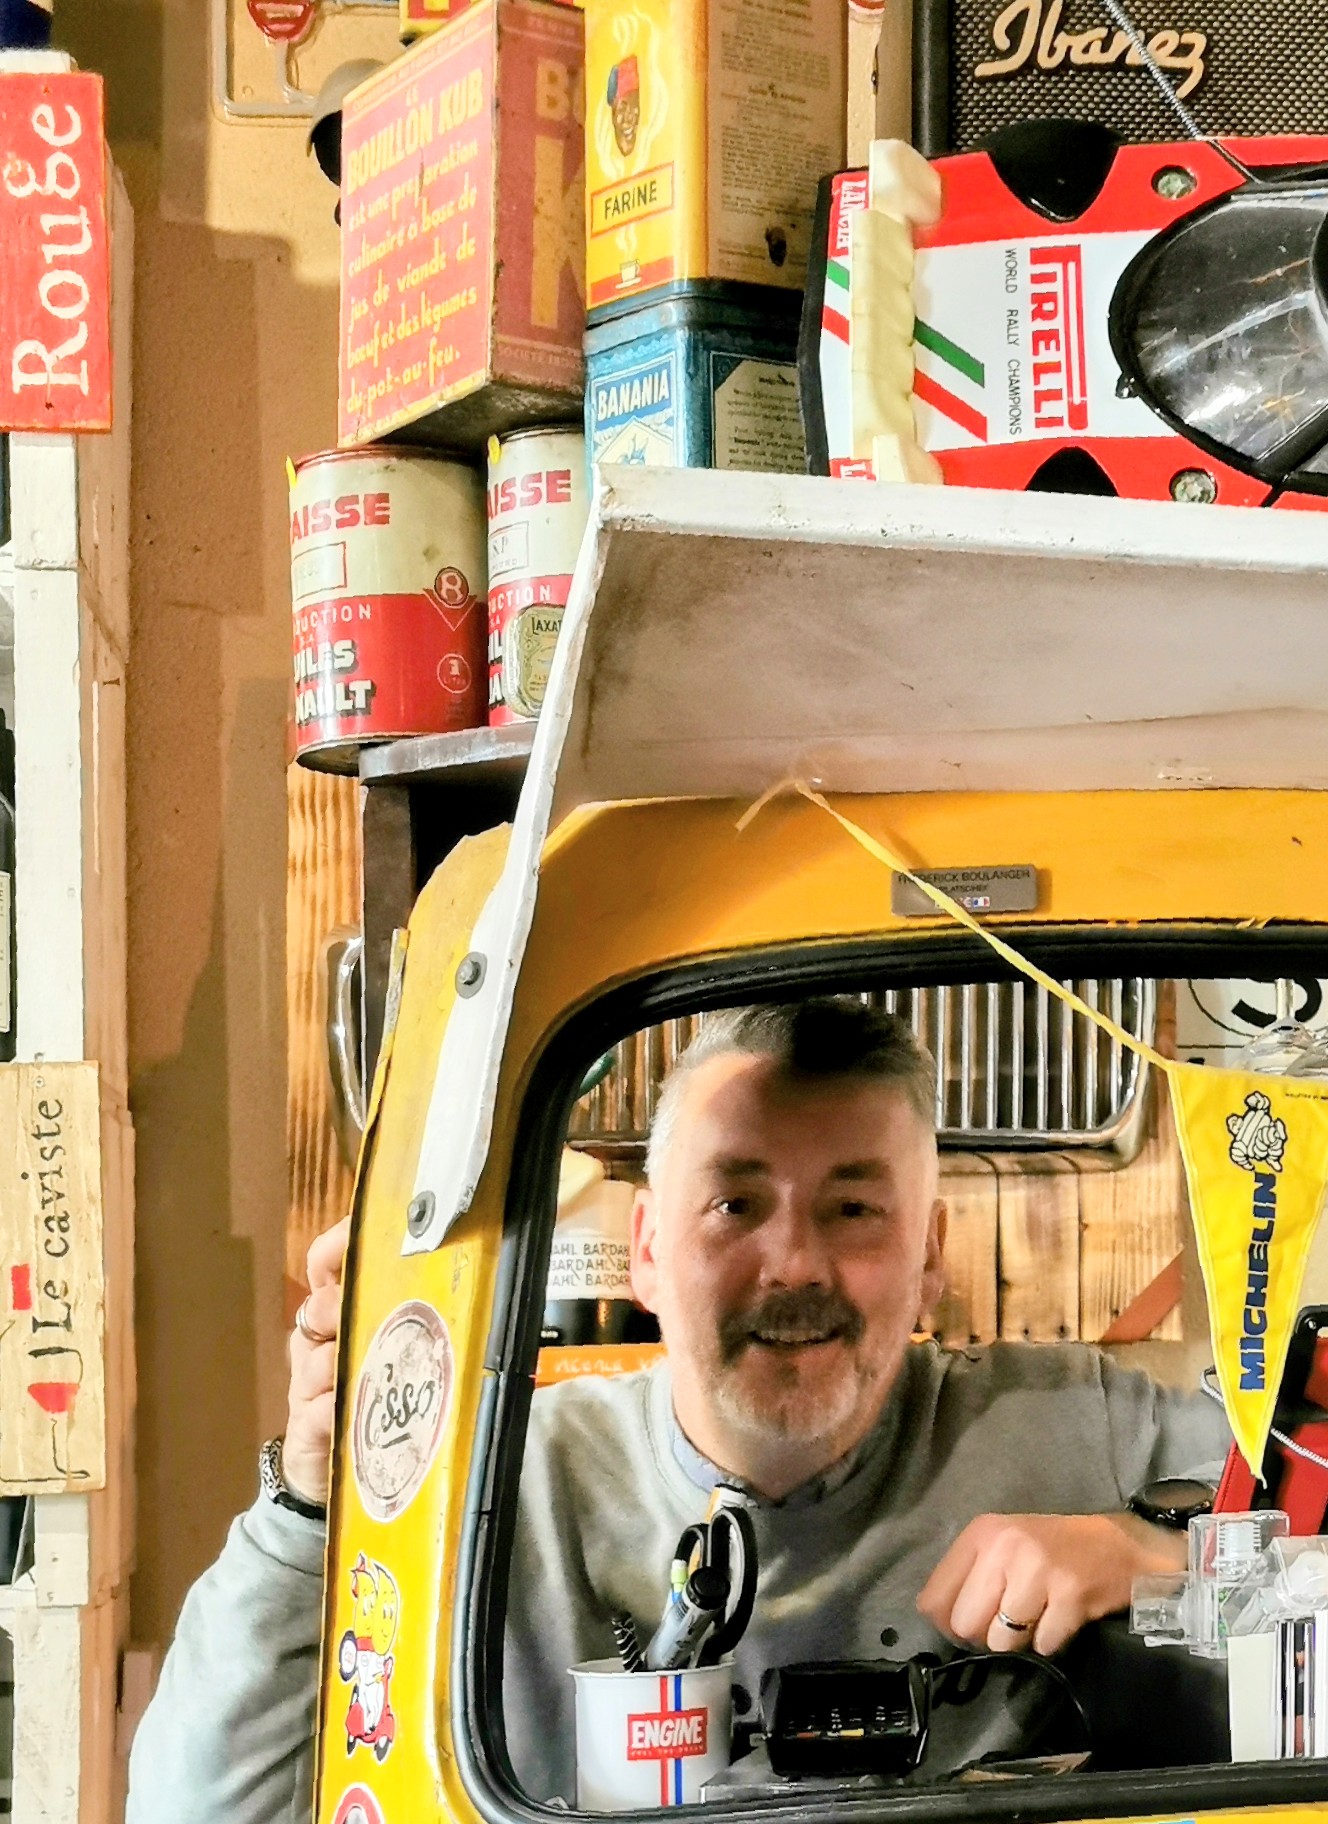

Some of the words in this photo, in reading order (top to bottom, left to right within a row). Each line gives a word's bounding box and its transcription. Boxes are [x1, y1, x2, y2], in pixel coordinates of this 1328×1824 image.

[974, 0, 1207, 99] Ibanez
[347, 98, 433, 196] BOUILLON
[438, 67, 483, 136] KUB
[422, 198, 454, 233] base
[458, 171, 478, 211] de
[604, 180, 657, 220] FARINE
[3, 101, 93, 398] Rouge
[1005, 248, 1018, 294] WORLD
[349, 290, 368, 333] jus
[373, 269, 389, 308] de
[397, 237, 447, 292] viande
[456, 222, 478, 262] de
[1007, 308, 1020, 347] RALLY
[1022, 243, 1089, 430] PIRELLI
[598, 370, 669, 421] BANANIA
[1007, 359, 1022, 435] CHAMPIONS
[291, 492, 391, 543] AISSE
[487, 470, 572, 520] AISSE
[295, 604, 372, 636] UCTION
[490, 583, 552, 616] UCTION
[532, 616, 563, 636] LAXAT
[294, 638, 357, 684] UILES
[295, 679, 373, 726] NAULT
[961, 869, 1031, 883] BOULANGER
[20, 1097, 69, 1257] caviste
[30, 1258, 73, 1335] Le
[1238, 1171, 1279, 1391] MICHELIN
[631, 1715, 703, 1749] ENGINE
